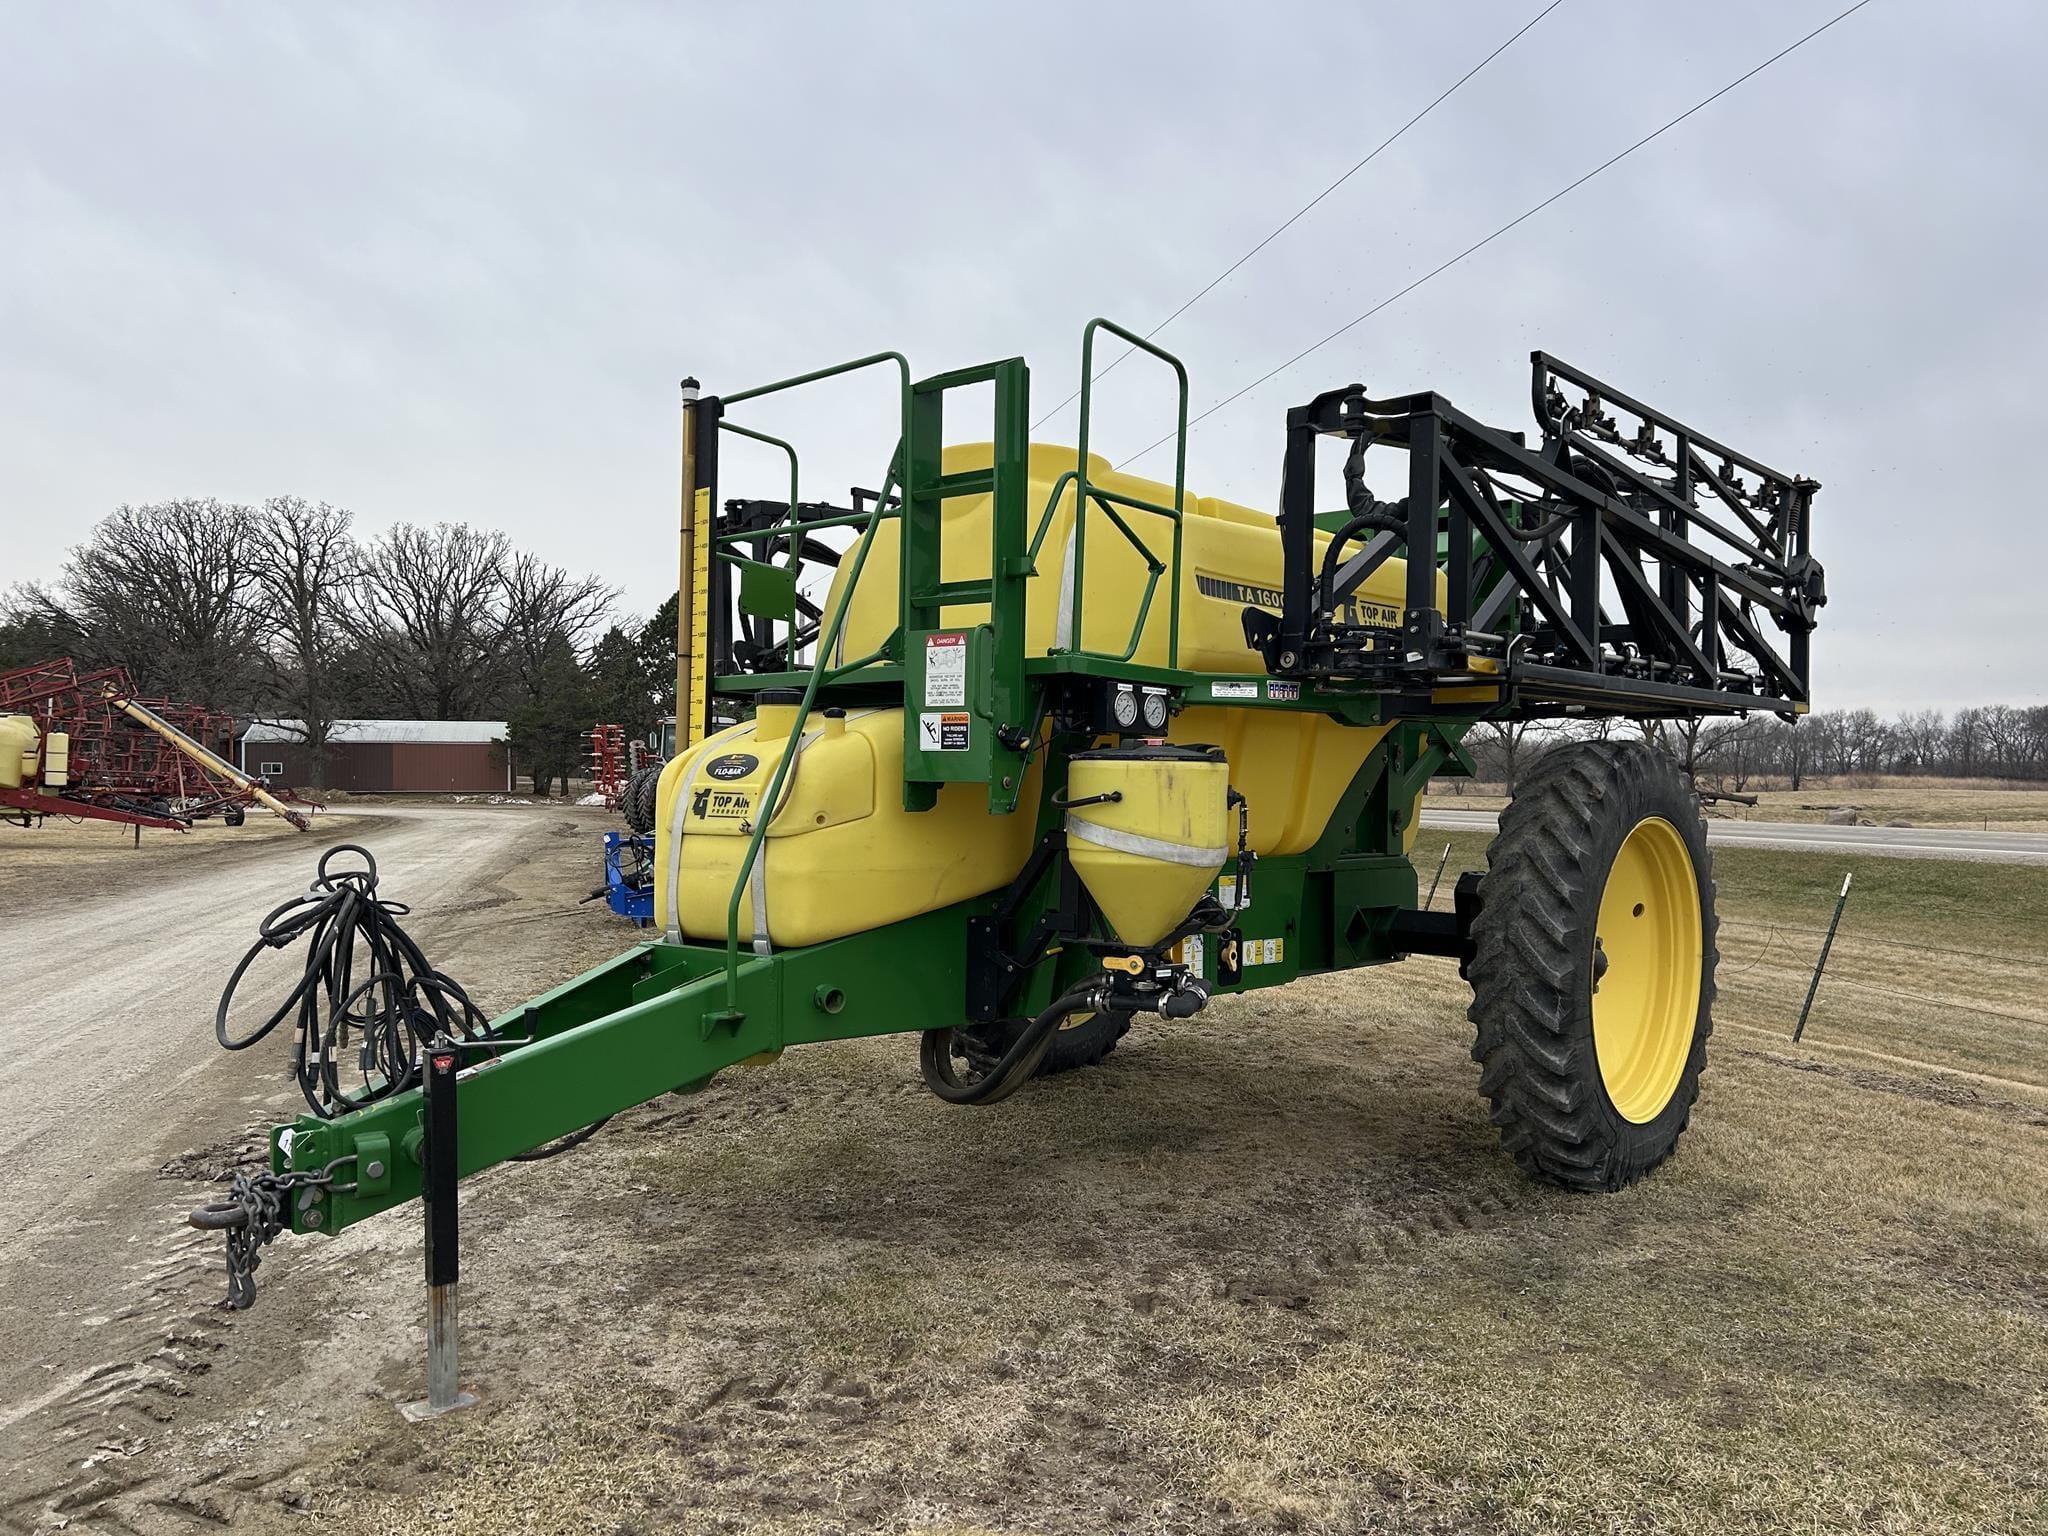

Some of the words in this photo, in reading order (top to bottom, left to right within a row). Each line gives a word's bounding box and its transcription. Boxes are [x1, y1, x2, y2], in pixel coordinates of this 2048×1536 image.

[1237, 586, 1255, 603] TA
[1360, 605, 1379, 620] TOP
[1382, 609, 1398, 623] AIR
[713, 795, 733, 808] TOP
